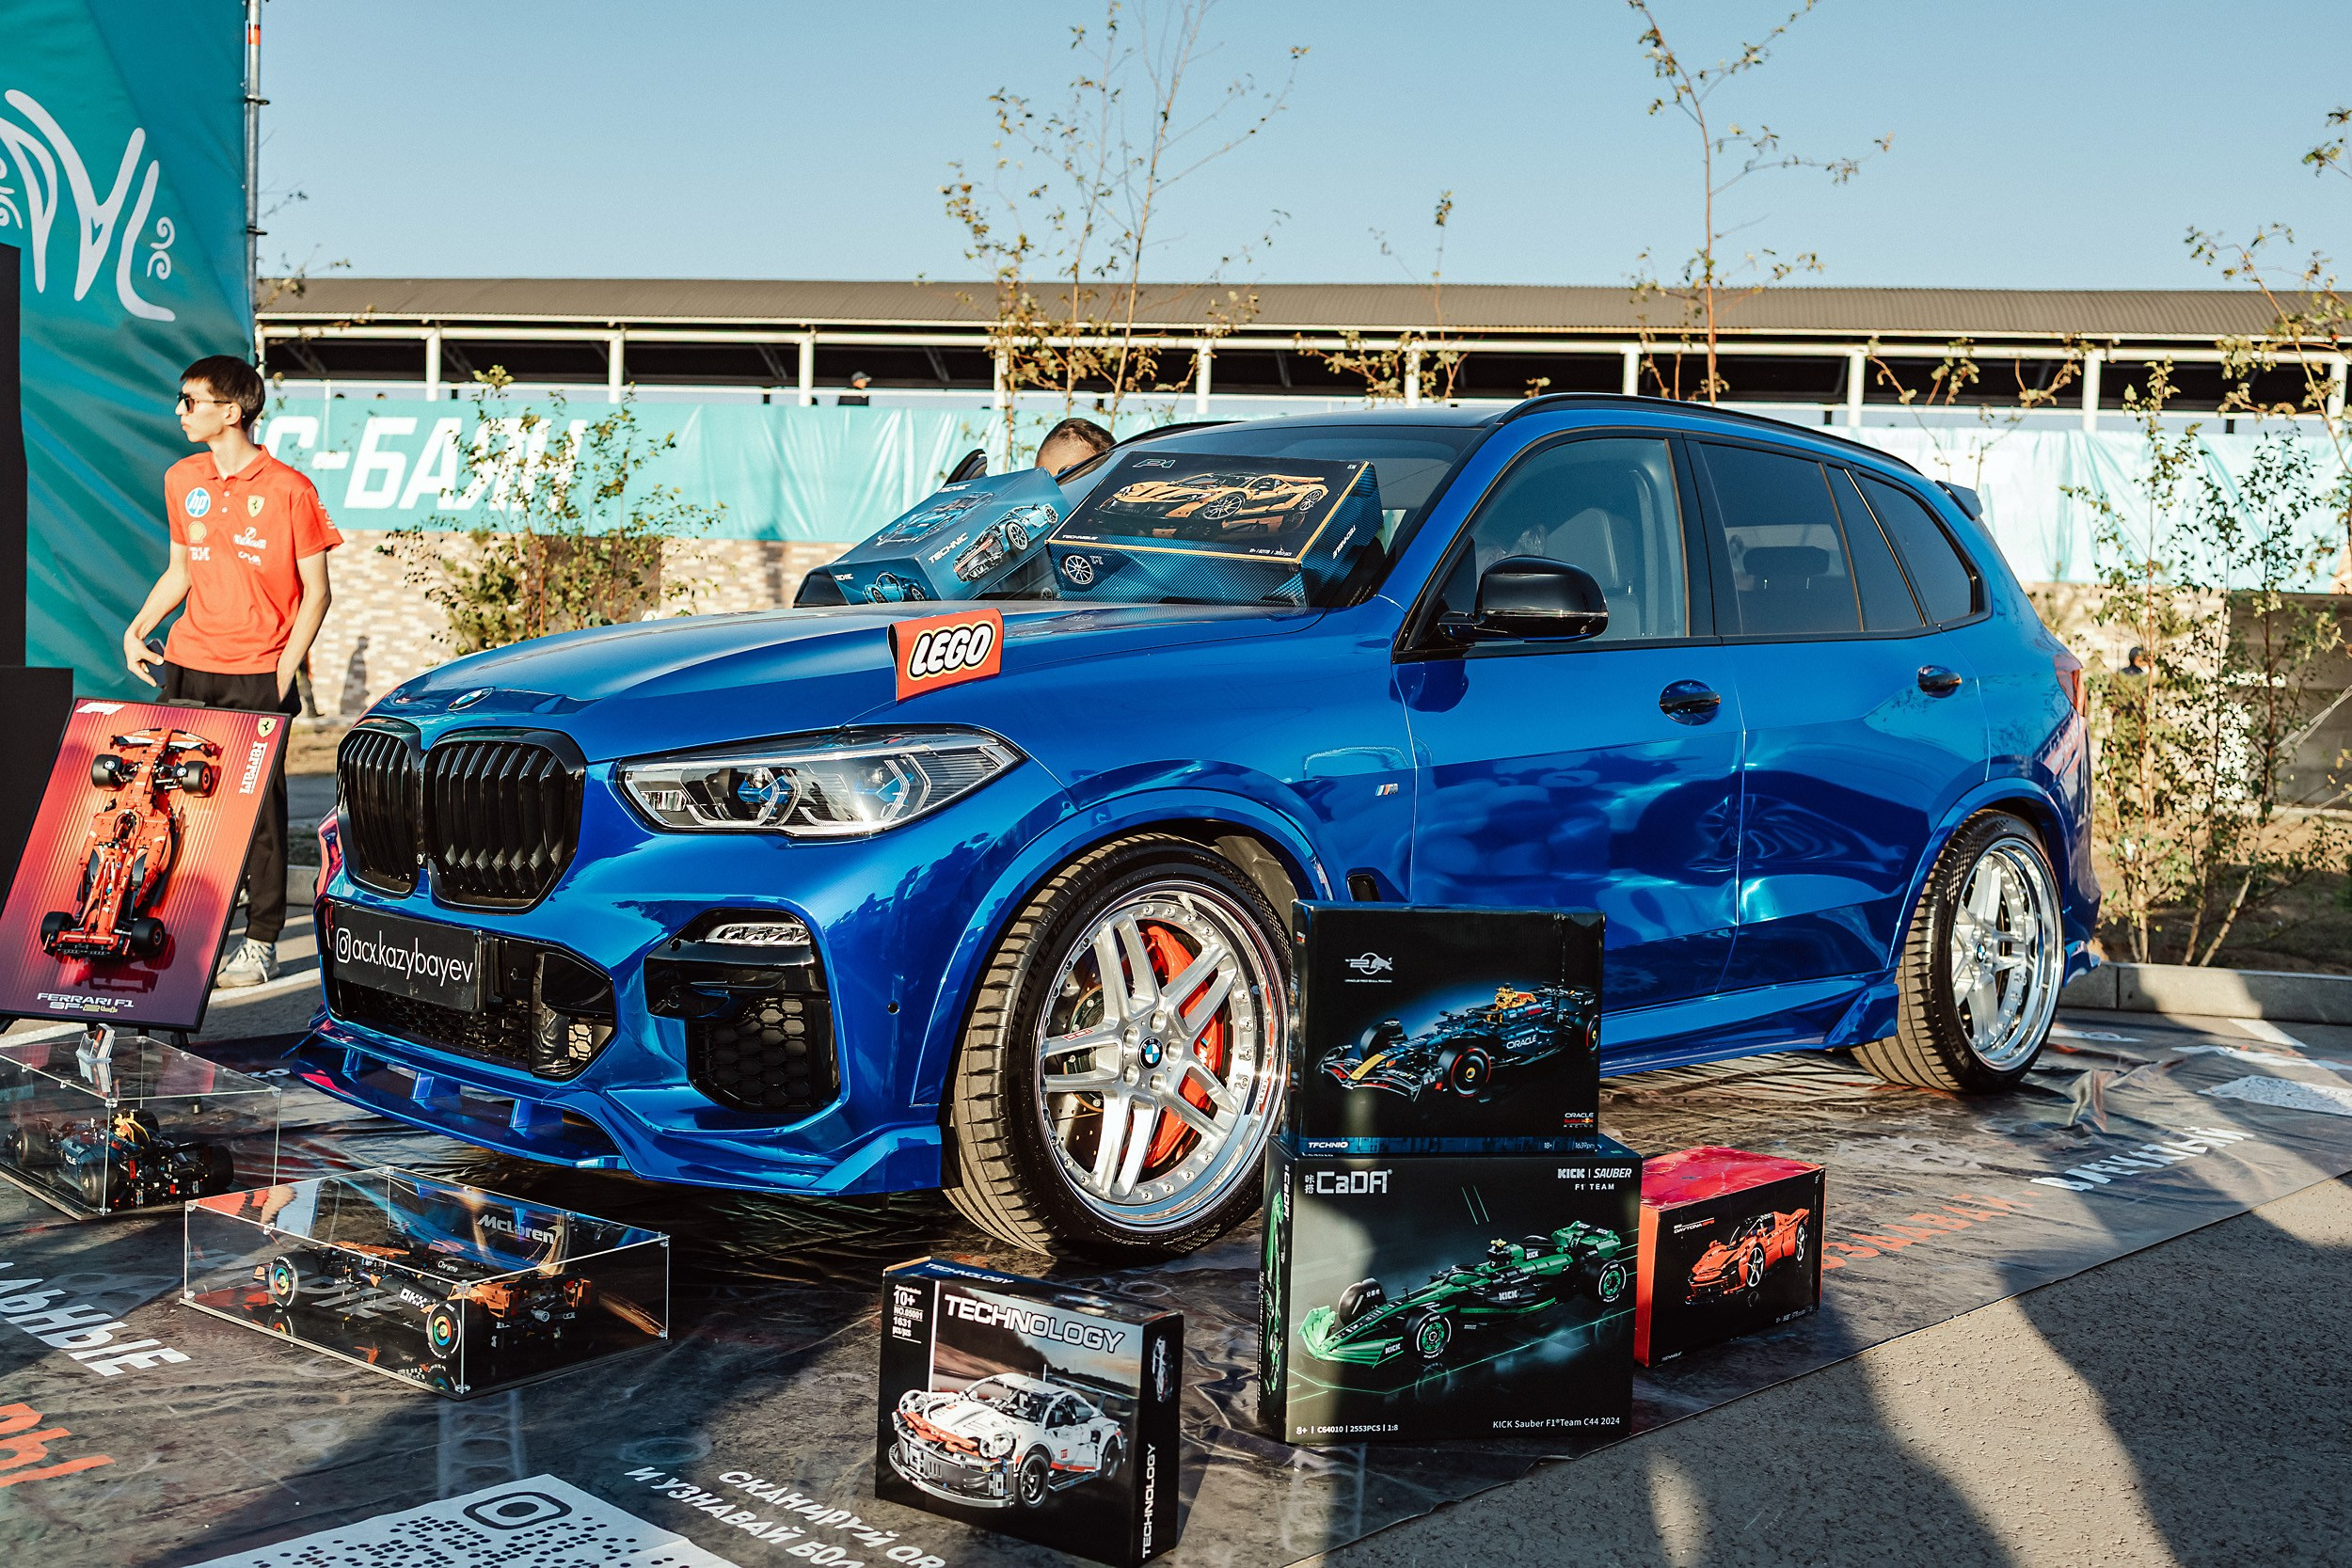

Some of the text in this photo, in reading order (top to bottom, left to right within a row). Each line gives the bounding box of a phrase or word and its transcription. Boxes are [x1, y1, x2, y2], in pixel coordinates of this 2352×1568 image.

[187, 488, 209, 517] hp
[928, 532, 969, 564] TECHNIC
[910, 624, 993, 677] LEGO
[239, 741, 268, 794] Ferrari
[352, 930, 473, 987] acx.kazybayev
[37, 992, 135, 1007] FERRARI F1
[1506, 1035, 1537, 1050] ORACLE
[1557, 1168, 1632, 1179] KICK SAUBER
[477, 1213, 556, 1244] McLaren
[925, 1262, 1015, 1284] TECHNOLOGY
[893, 1291, 915, 1306] 10+
[1499, 1290, 1518, 1301] KICK
[893, 1317, 912, 1328] 1631
[945, 1293, 1125, 1354] TECHNOLOGY
[1385, 1343, 1401, 1354] KICK
[1295, 1426, 1308, 1435] 8+
[1316, 1425, 1343, 1433] C64010
[1349, 1424, 1381, 1433] 2553PCS
[1492, 1420, 1513, 1429] KICK
[1514, 1419, 1544, 1428] Sauber
[1583, 1418, 1598, 1426] C44
[1600, 1417, 1620, 1425] 2024
[624, 1465, 666, 1482] И
[650, 1477, 806, 1544] УЗНАВАЙ
[718, 1471, 900, 1548] СКАНИРУЙ
[1142, 1443, 1156, 1559] TECHNOLOGY
